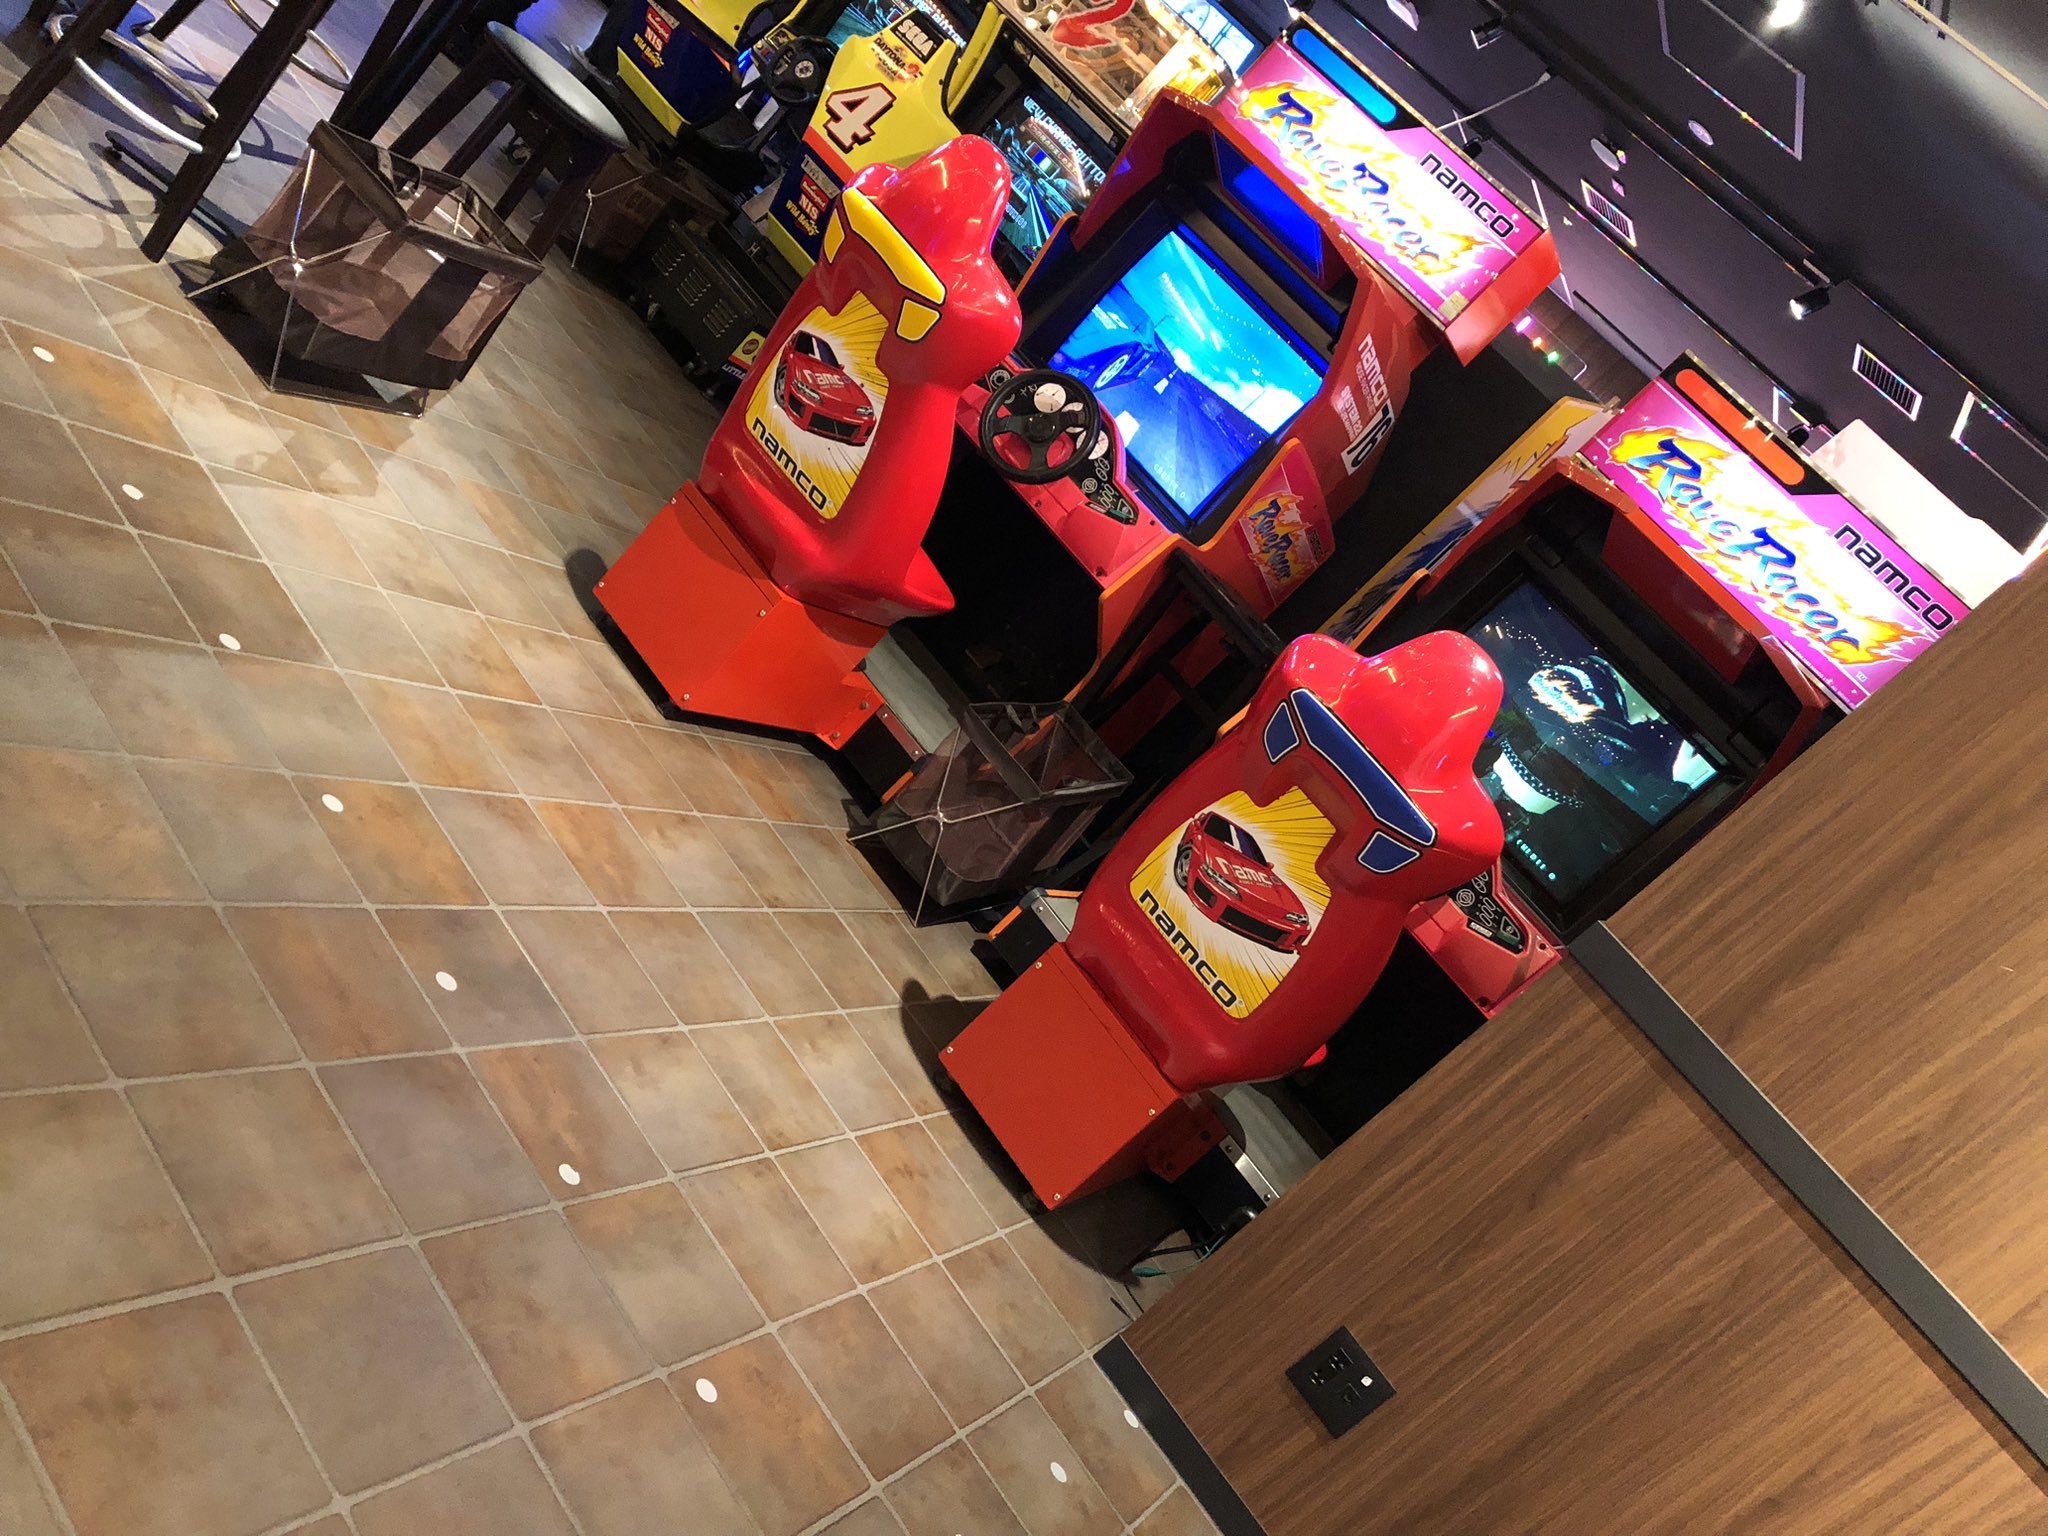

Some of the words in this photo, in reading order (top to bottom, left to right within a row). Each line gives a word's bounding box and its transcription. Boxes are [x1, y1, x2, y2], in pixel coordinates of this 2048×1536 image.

[873, 37, 907, 70] DAYTONA
[897, 19, 934, 57] SEGA
[825, 82, 896, 154] 4
[1023, 95, 1047, 121] VIEW
[1042, 116, 1078, 152] CHANGE
[1075, 147, 1107, 184] BUTTO
[785, 199, 801, 218] Wild
[799, 194, 819, 221] NIS
[1420, 152, 1516, 238] namco
[1358, 333, 1390, 407] namco
[1340, 385, 1360, 424] SYSTEM
[1352, 418, 1364, 436] 22
[1346, 402, 1393, 469] 76
[752, 416, 829, 509] namco
[1249, 497, 1282, 547] Rave
[1627, 438, 1742, 543] Rave
[1716, 527, 1860, 651] Racer
[1834, 525, 1953, 631] namco
[1217, 857, 1281, 887] namco
[1139, 889, 1238, 1009] namco
